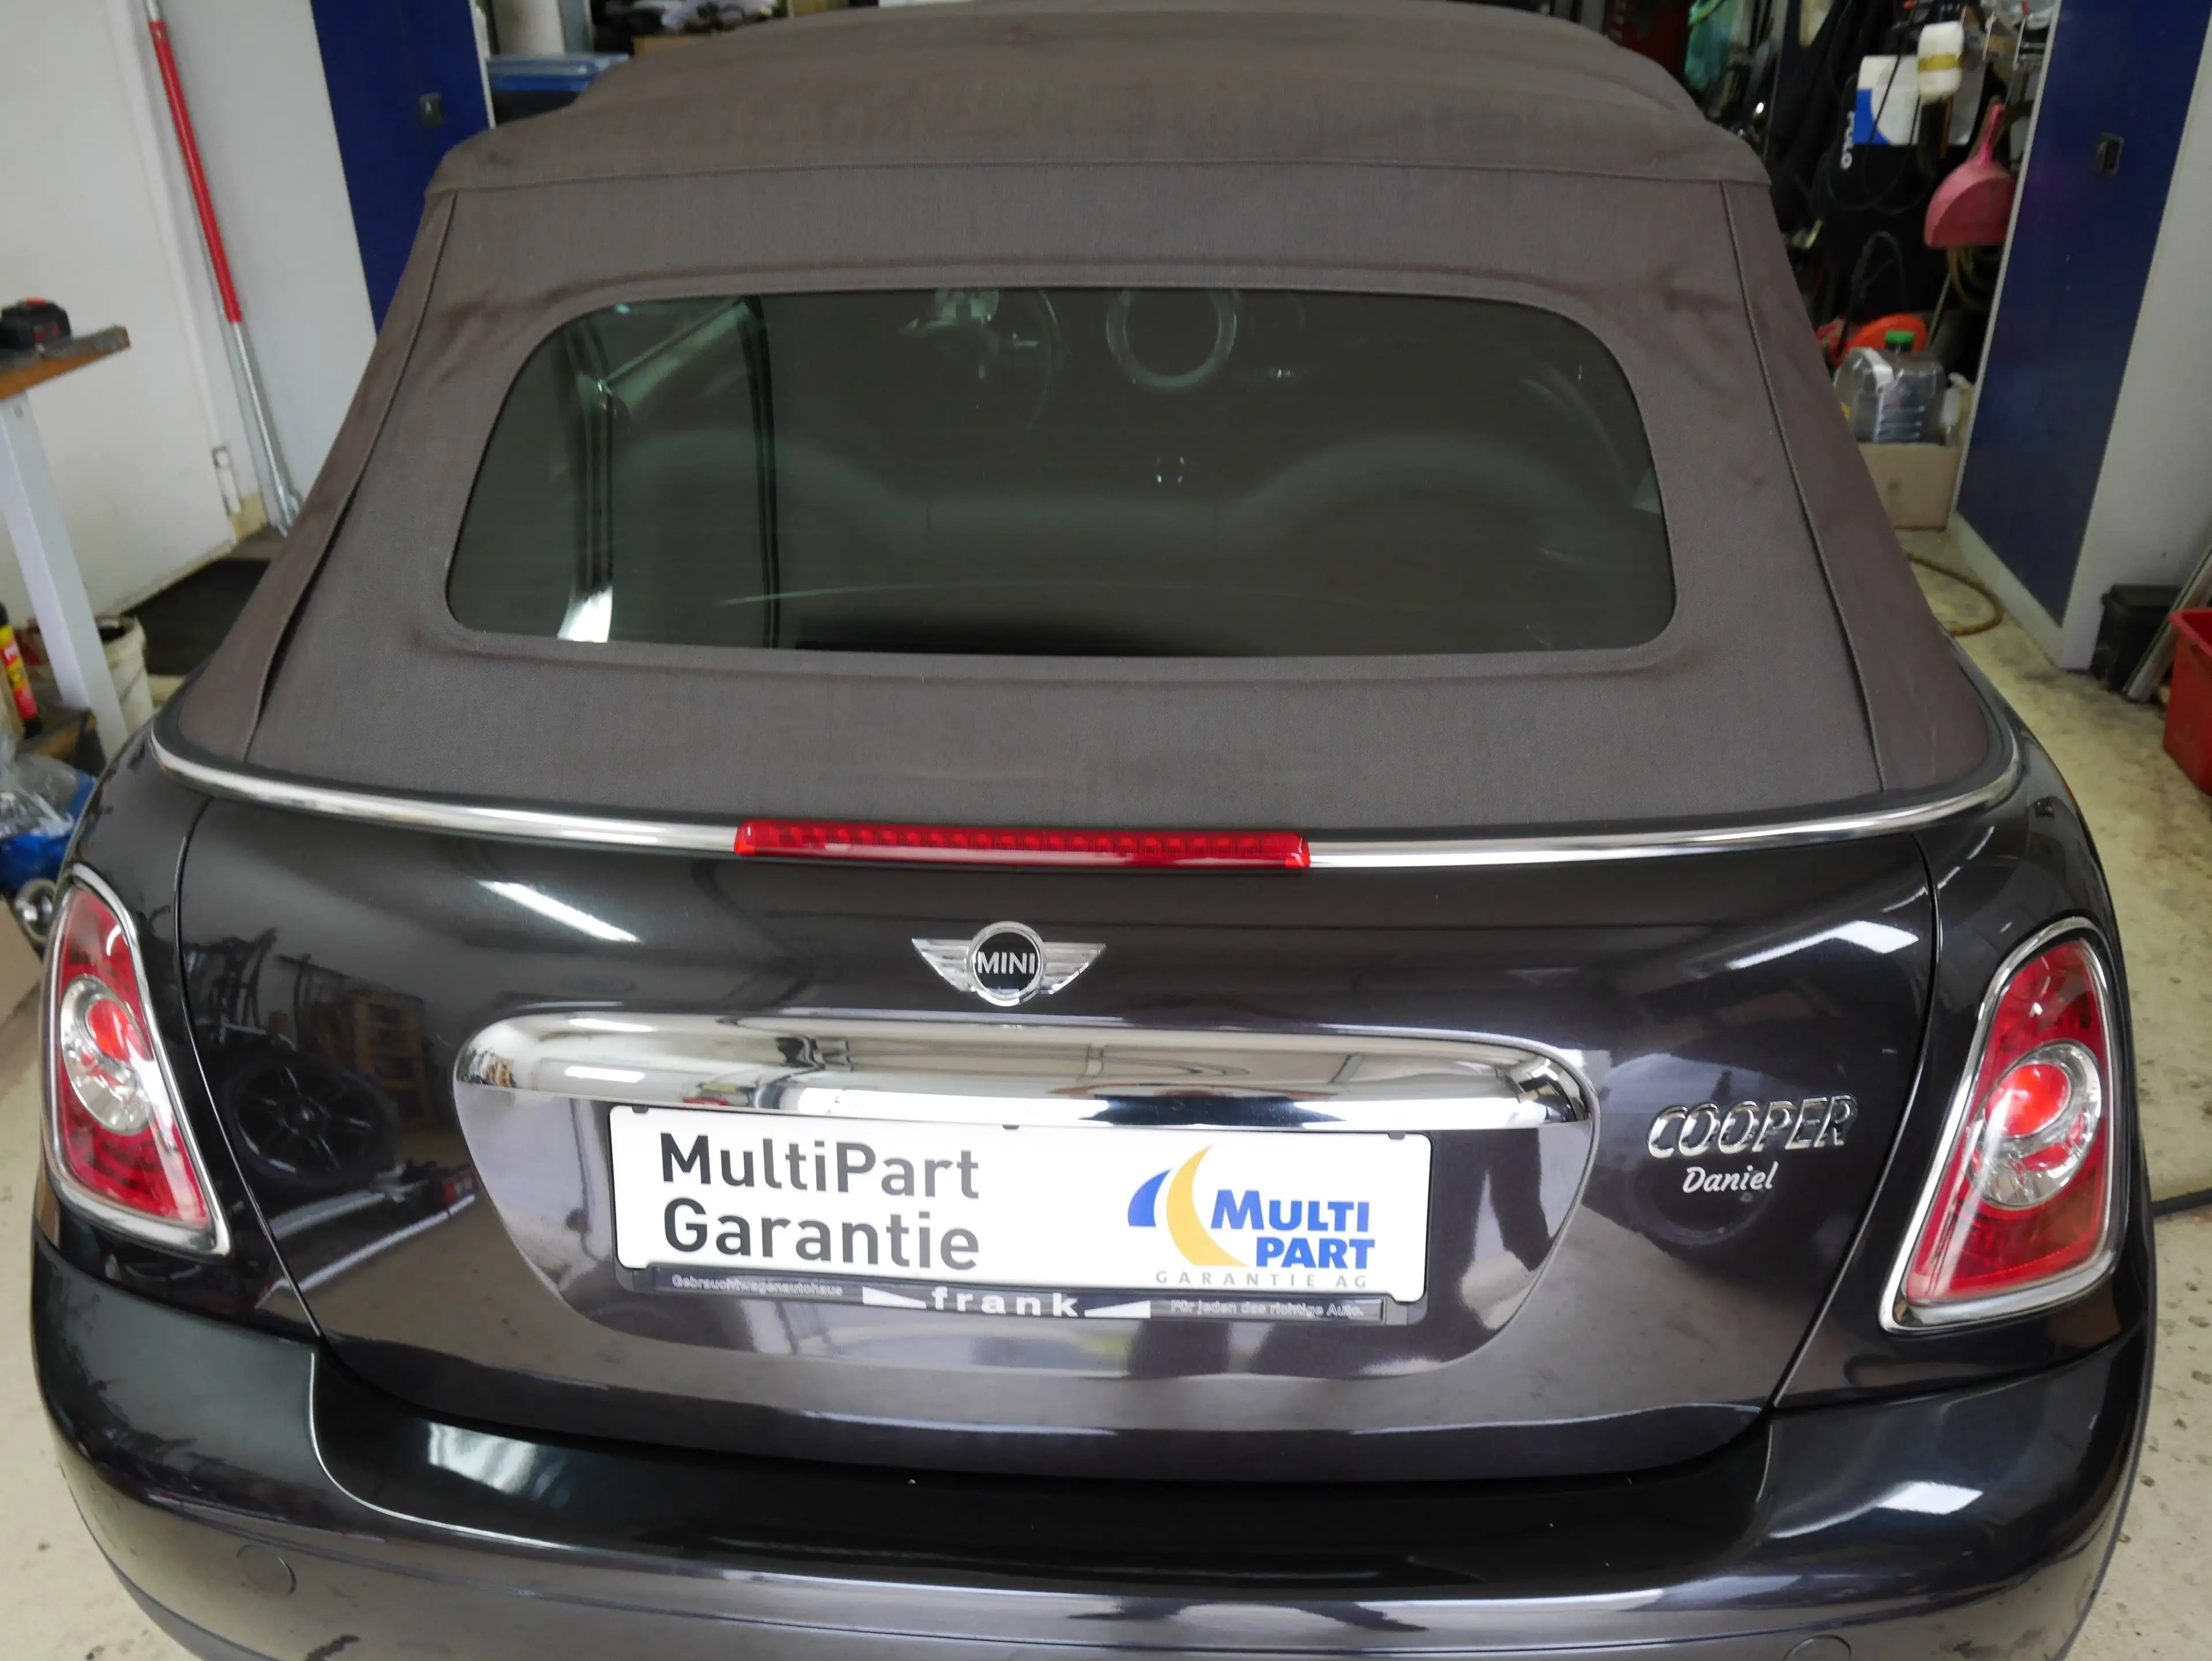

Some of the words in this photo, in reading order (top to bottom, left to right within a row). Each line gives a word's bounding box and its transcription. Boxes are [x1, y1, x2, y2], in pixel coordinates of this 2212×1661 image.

[978, 952, 1035, 974] MINI
[1647, 1095, 1857, 1159] COOPER
[659, 1132, 979, 1200] MultiPart
[1683, 1161, 1778, 1193] Daniel
[663, 1197, 979, 1271] Garantie
[1256, 1237, 1375, 1269] PART
[1155, 1271, 1316, 1288] GARANTIE
[1336, 1275, 1366, 1288] AG
[931, 1286, 1079, 1318] frank
[1171, 1299, 1195, 1313] Für
[1197, 1300, 1237, 1315] jeden
[1270, 1302, 1324, 1317] richtige
